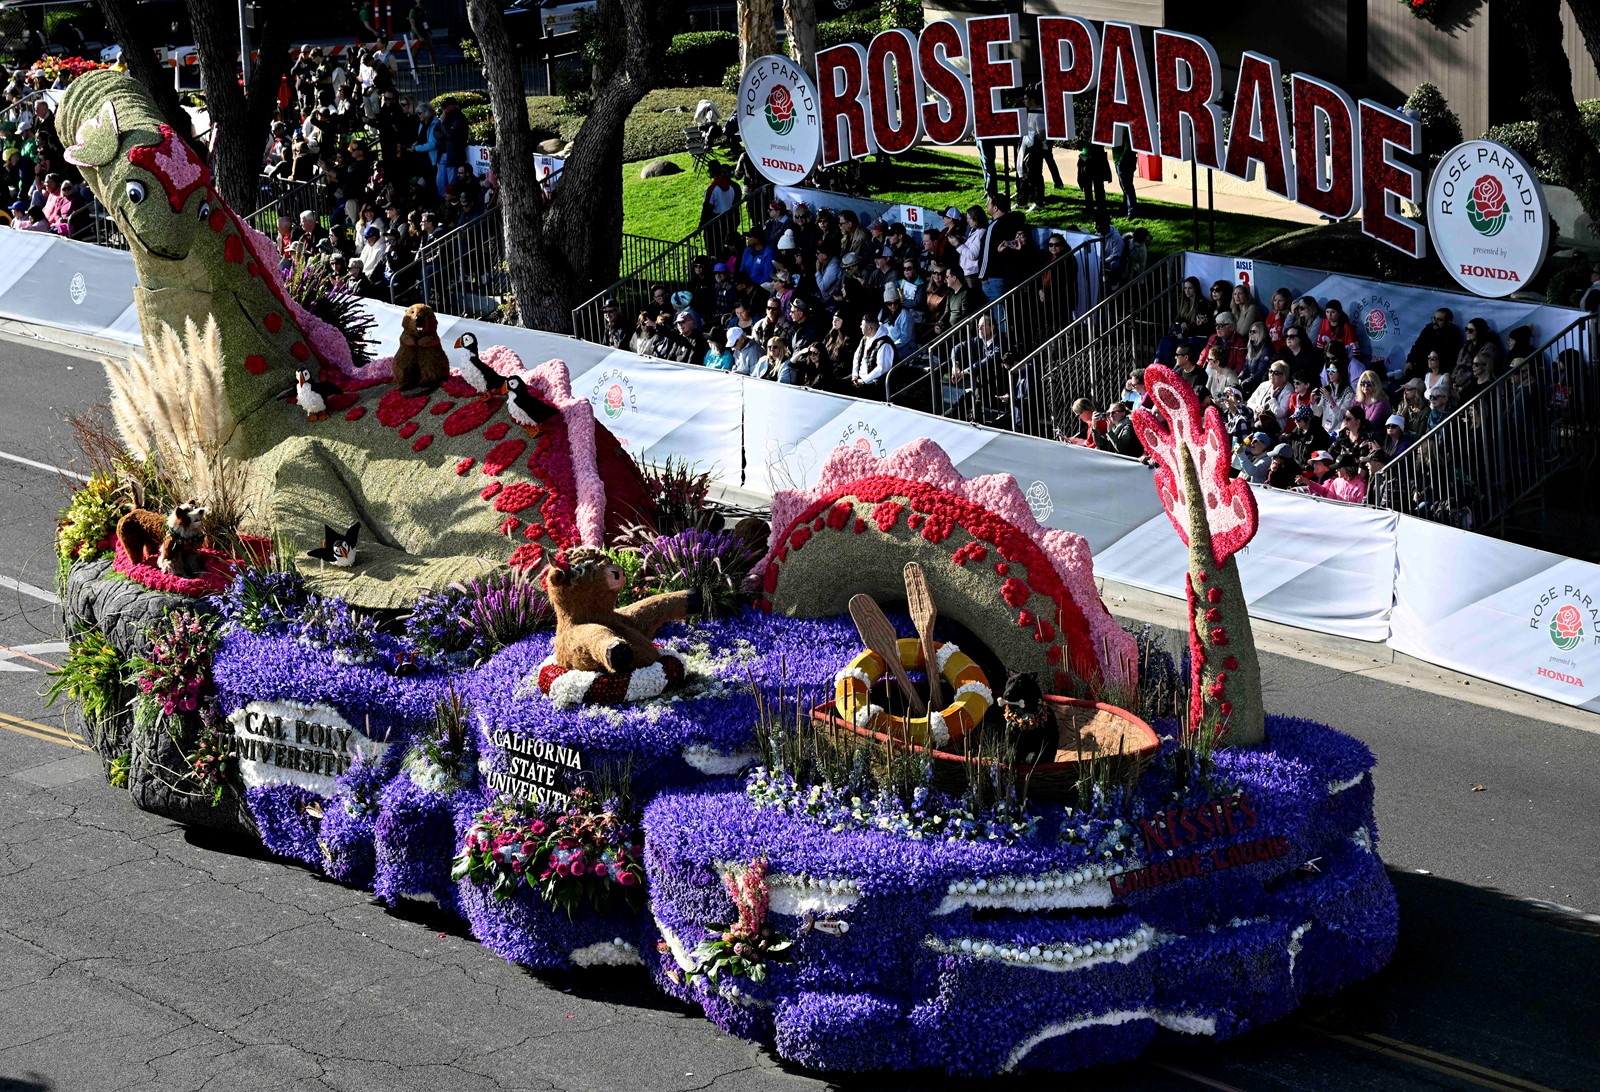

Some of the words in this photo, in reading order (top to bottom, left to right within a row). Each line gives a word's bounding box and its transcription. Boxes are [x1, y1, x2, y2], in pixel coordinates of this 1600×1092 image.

[746, 66, 768, 117] ROSE
[771, 62, 817, 126] PARADE
[479, 148, 489, 160] 15
[770, 143, 789, 152] presented
[790, 144, 796, 154] by
[815, 13, 1027, 167] ROSE
[1037, 16, 1425, 260] PARADE
[761, 157, 806, 174] HONDA
[1441, 154, 1472, 215] ROSE
[1477, 148, 1536, 223] PARADE
[906, 207, 918, 222] 15
[1236, 261, 1252, 270] AISLE
[1472, 246, 1499, 256] presented
[1500, 248, 1507, 258] by
[1460, 264, 1521, 282] HONDA
[1371, 295, 1401, 336] PARADE
[590, 371, 609, 406] ROSE
[612, 368, 638, 414] PARADE
[839, 424, 855, 446] OSE
[857, 421, 887, 458] PARAD
[1530, 587, 1558, 630] ROSE
[1537, 666, 1584, 687] HONDA
[245, 711, 287, 740] CAL
[294, 719, 352, 752] POLY
[494, 729, 581, 770] CALIFORNIA
[510, 757, 556, 787] STATE
[486, 771, 571, 813] UNIVERSITY
